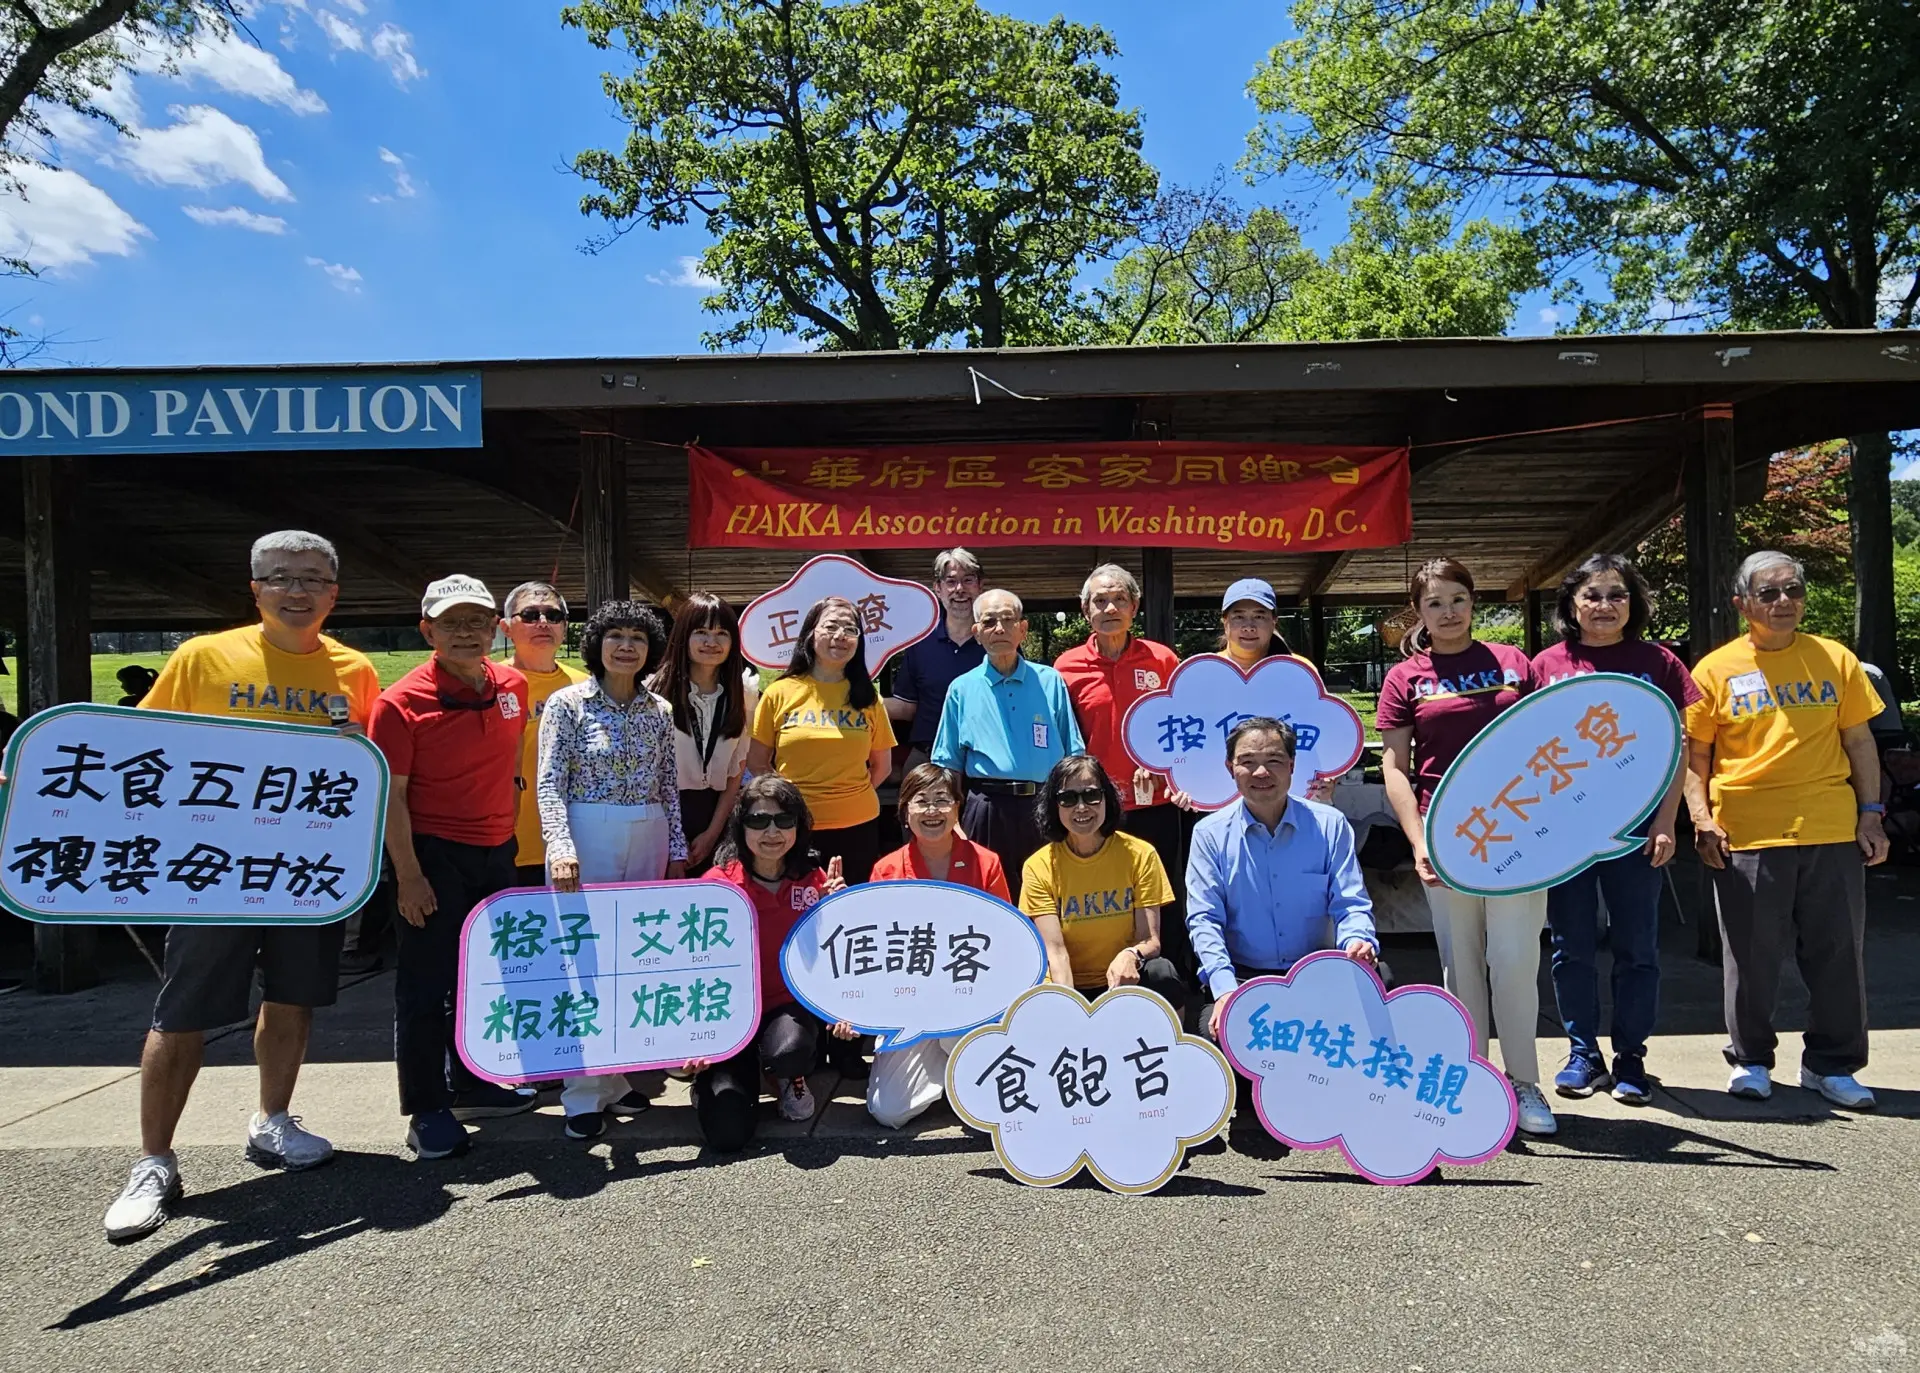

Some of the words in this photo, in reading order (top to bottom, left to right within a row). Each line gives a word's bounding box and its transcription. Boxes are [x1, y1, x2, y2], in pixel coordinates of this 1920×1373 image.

[0, 390, 131, 440] OND
[149, 385, 467, 437] PAVILION
[725, 503, 842, 537] HAKKA
[849, 505, 1041, 536] Association
[1052, 508, 1082, 534] in
[1096, 506, 1292, 545] Washington,
[1301, 507, 1368, 541] D.C.
[437, 583, 476, 595] HAKKA
[1411, 668, 1521, 700] HAKKA
[229, 682, 330, 714] HAKK
[1732, 680, 1838, 716] HAKKA
[783, 709, 868, 729] HAKKA
[37, 743, 359, 819] 未食五月粽
[52, 808, 69, 818] mi
[191, 813, 215, 822] ngu
[254, 816, 281, 825] ngied
[1535, 826, 1549, 838] ha
[37, 895, 55, 904] au
[114, 896, 129, 905] po
[244, 896, 265, 905] gam
[293, 898, 321, 907] biong
[489, 909, 600, 960] 粽子
[639, 957, 660, 966] ngie
[894, 986, 916, 997] gong
[644, 1037, 655, 1046] gi
[690, 1030, 716, 1041] zung
[554, 1044, 585, 1055] zung
[1246, 1003, 1470, 1115] 細妹按靚
